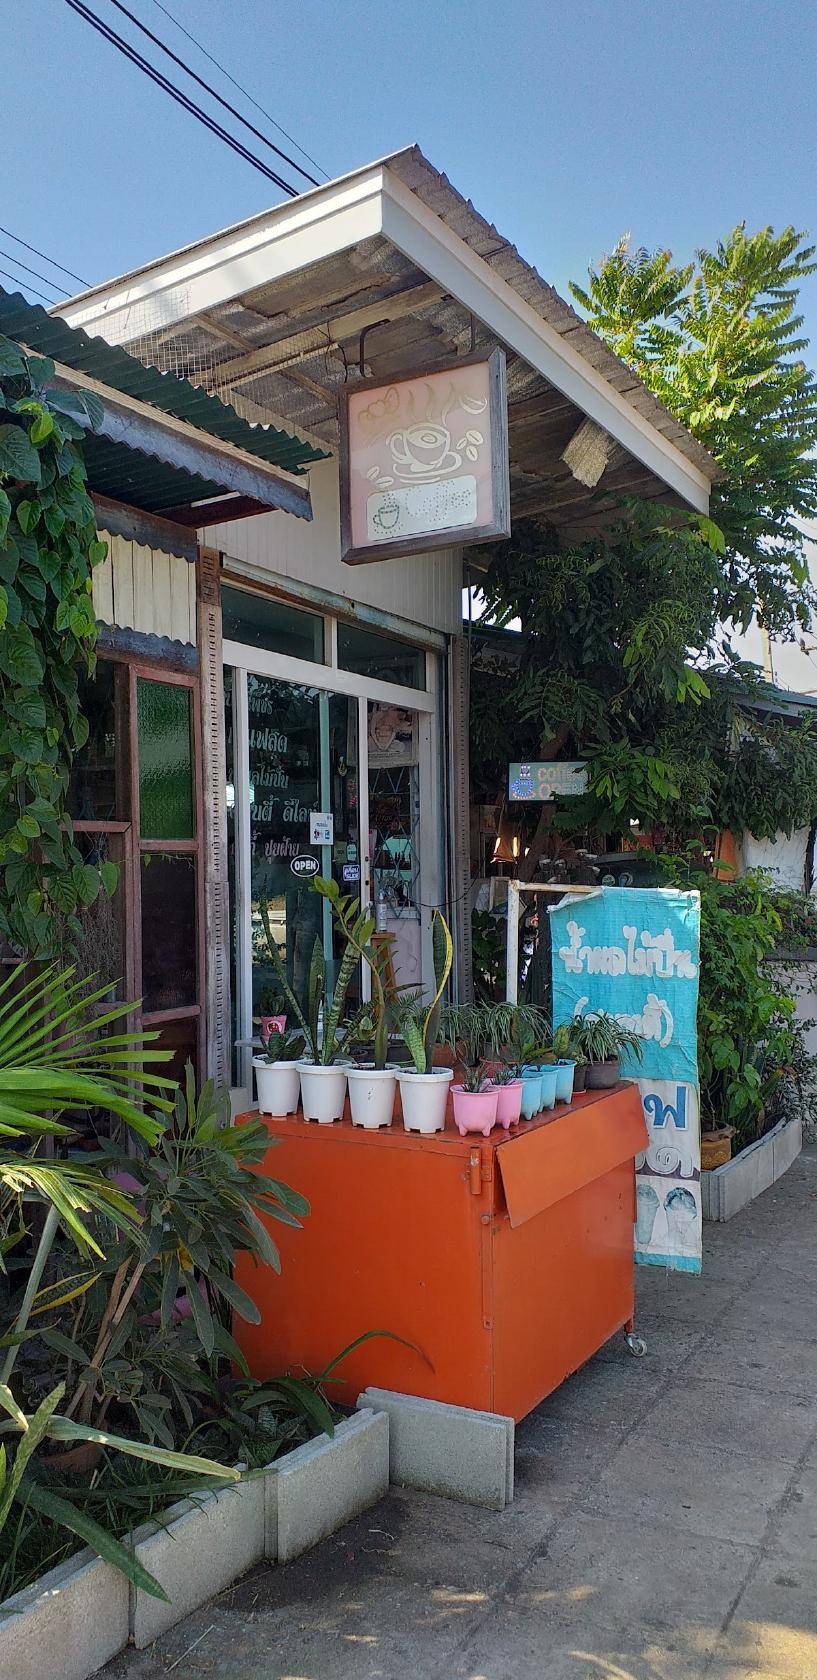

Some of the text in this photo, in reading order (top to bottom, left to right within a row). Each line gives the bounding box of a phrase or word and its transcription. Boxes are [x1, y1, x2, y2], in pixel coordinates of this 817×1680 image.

[250, 763, 289, 789] ลไม้ปั่น
[294, 860, 317, 871] OPEN
